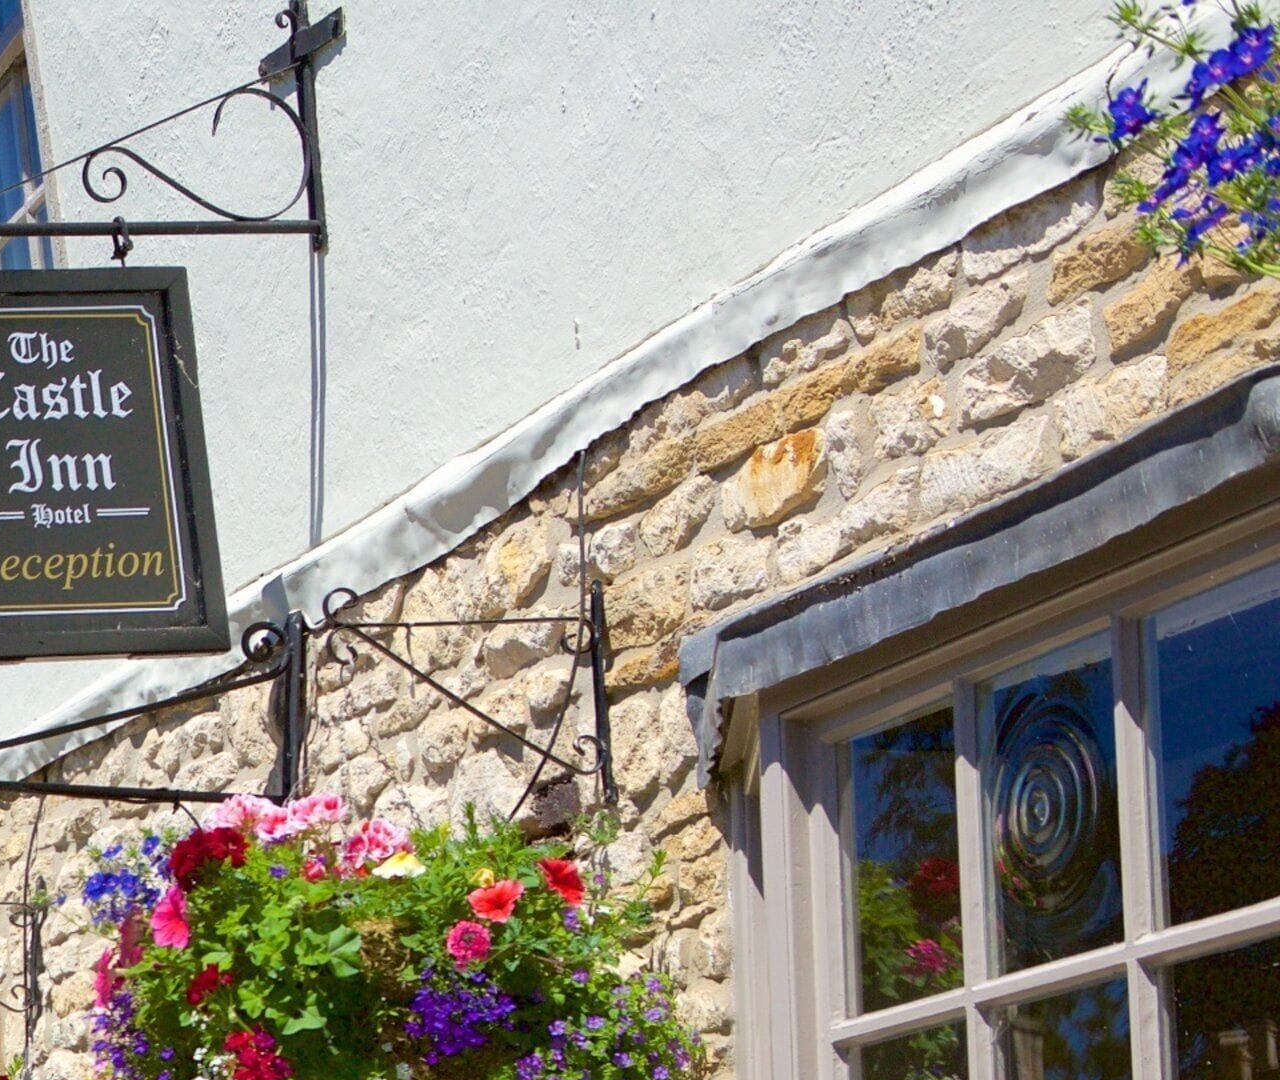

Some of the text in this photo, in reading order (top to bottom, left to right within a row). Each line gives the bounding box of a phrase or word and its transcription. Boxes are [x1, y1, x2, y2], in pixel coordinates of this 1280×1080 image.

[8, 332, 74, 369] The
[6, 439, 116, 494] Inn
[31, 504, 91, 528] Hotel
